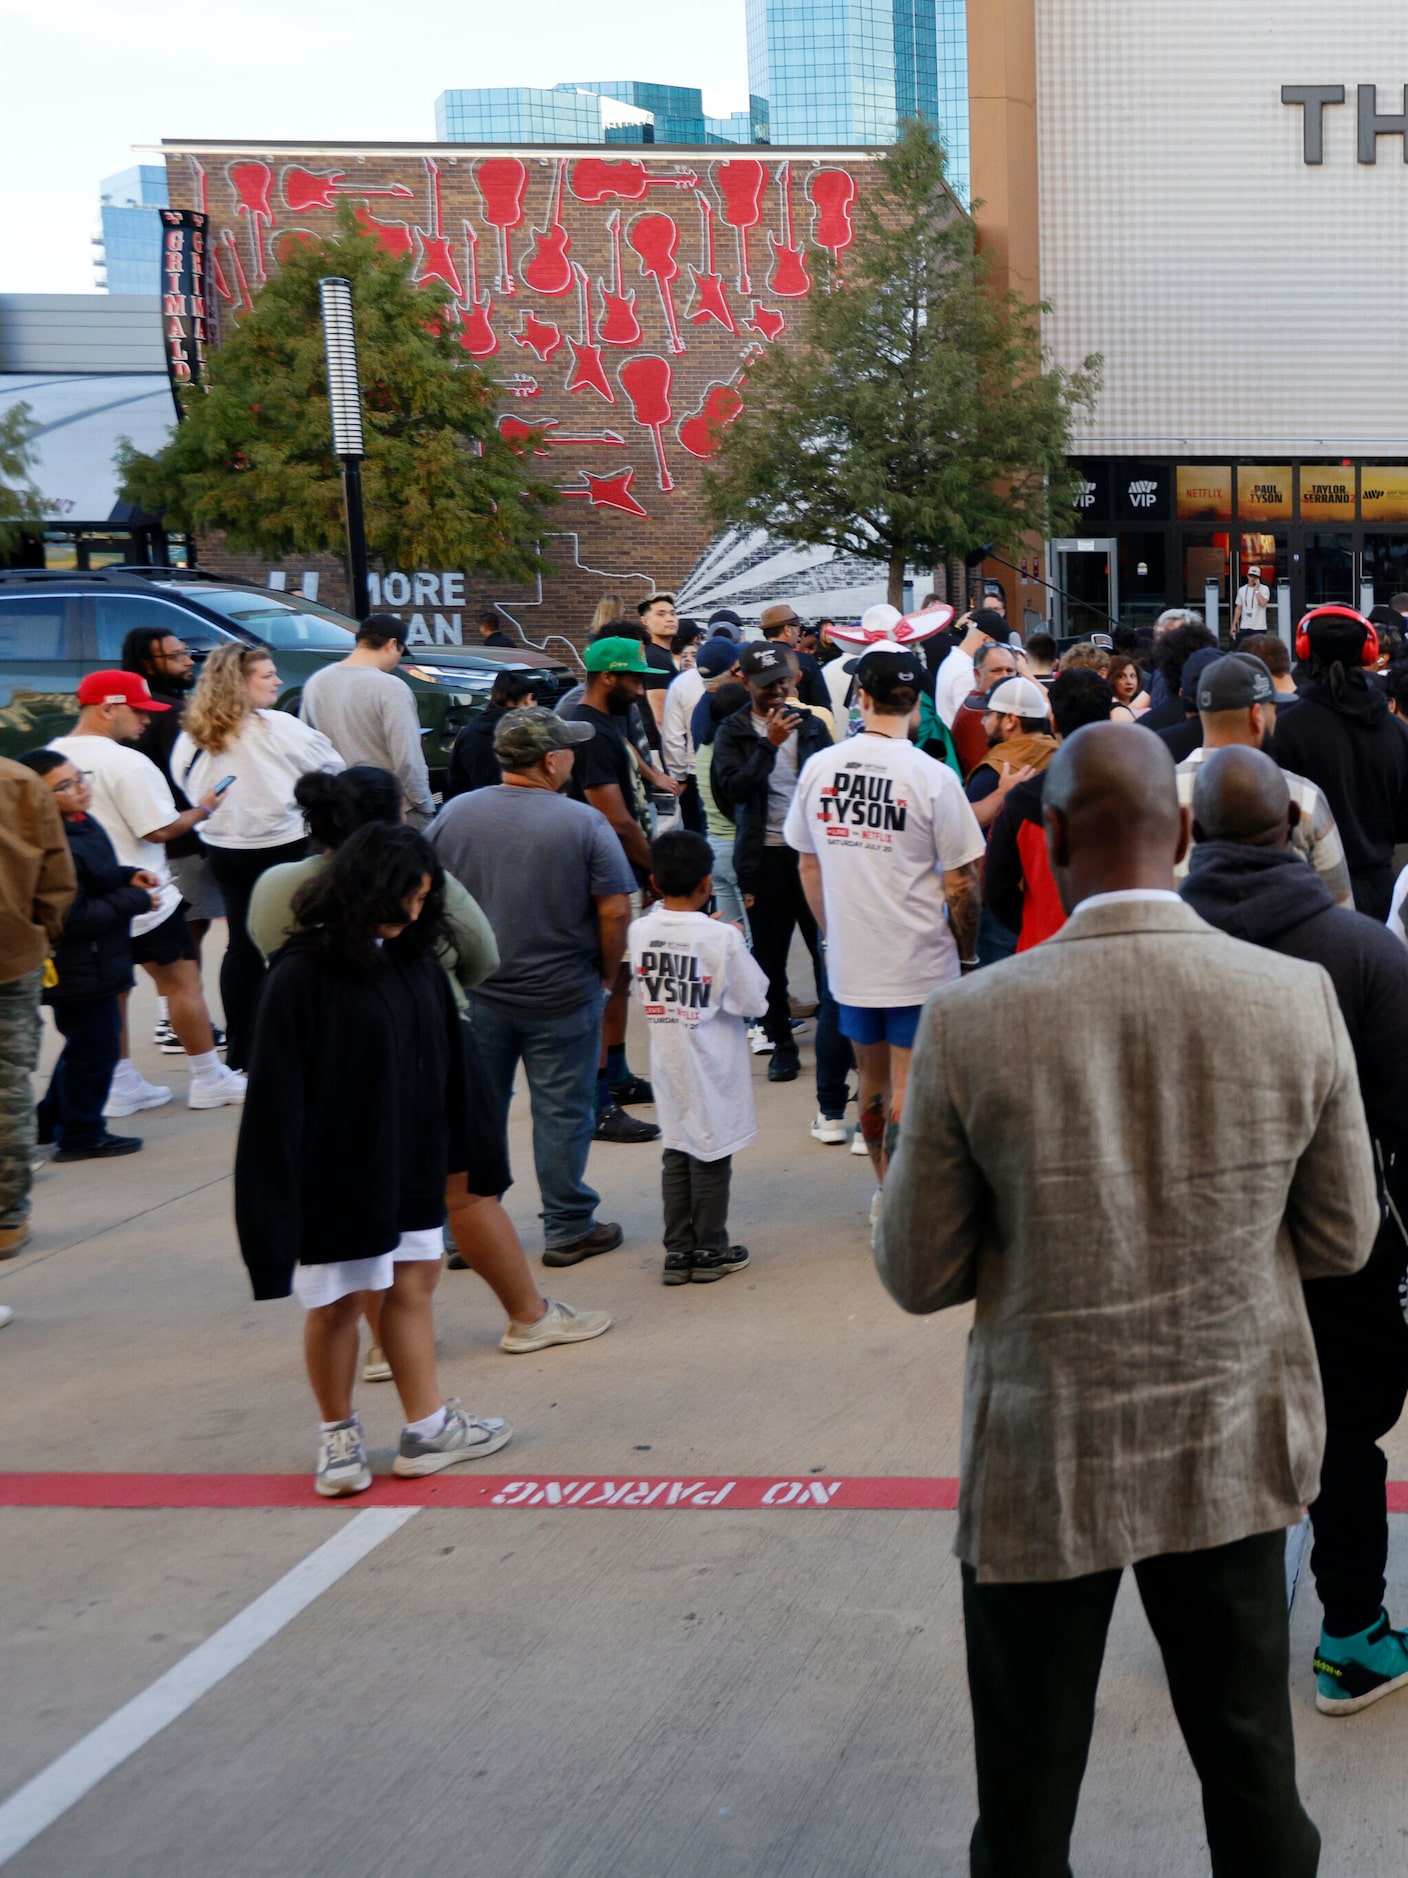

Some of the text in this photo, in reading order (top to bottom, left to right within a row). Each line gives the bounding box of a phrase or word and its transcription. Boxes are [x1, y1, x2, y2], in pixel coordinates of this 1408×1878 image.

[1186, 488, 1222, 499] NETFLIX
[1250, 493, 1282, 504] TYSON
[1254, 485, 1278, 495] PAUL
[1312, 484, 1346, 494] TAYLOR
[1130, 494, 1157, 507] VIP
[831, 772, 894, 804] PAUL
[820, 797, 908, 832] TYSON
[641, 951, 701, 982] PAUL
[637, 976, 713, 1008] YSON
[491, 1480, 842, 1506] NO PARKING
